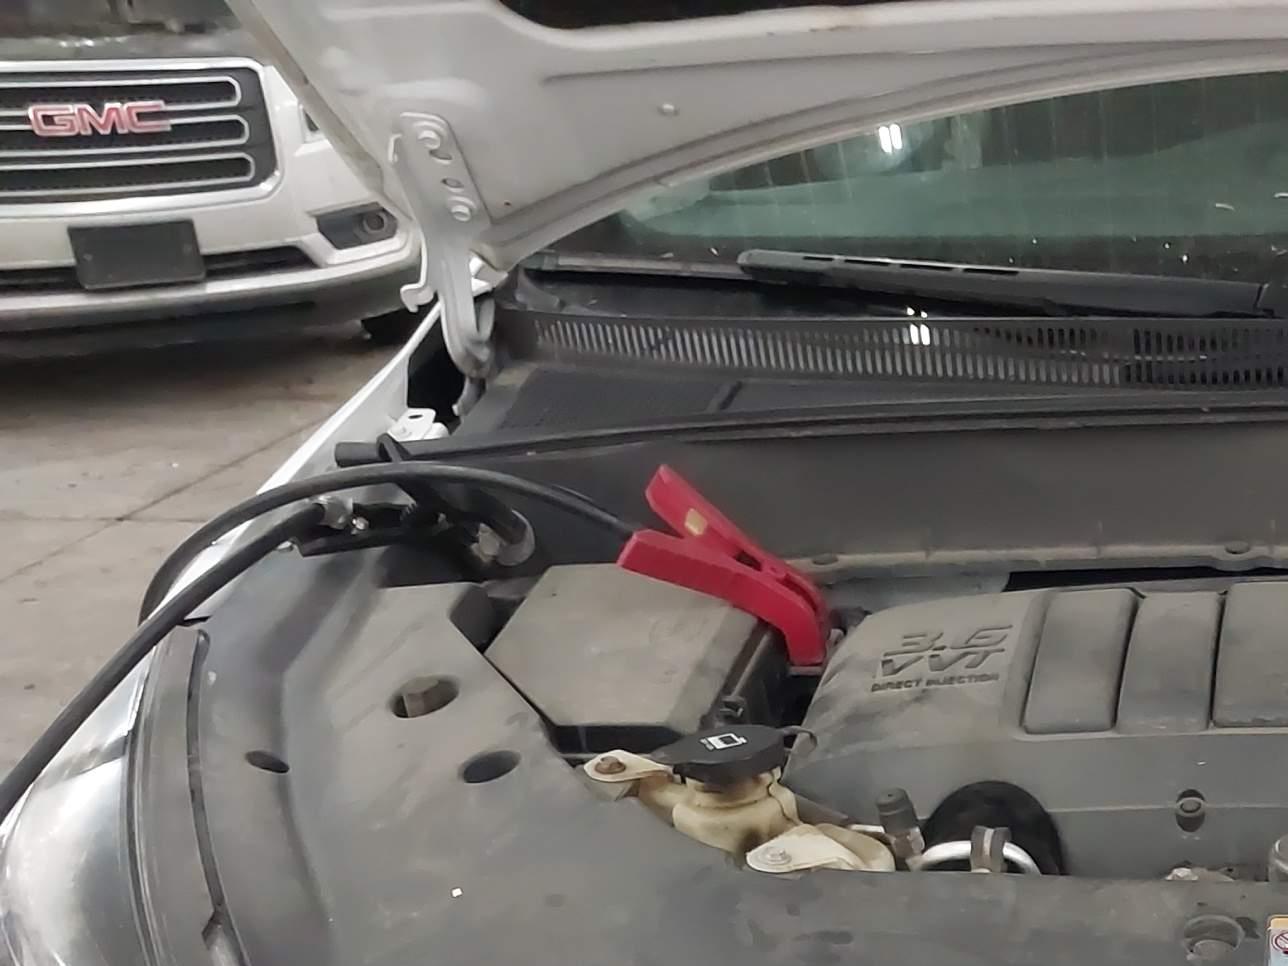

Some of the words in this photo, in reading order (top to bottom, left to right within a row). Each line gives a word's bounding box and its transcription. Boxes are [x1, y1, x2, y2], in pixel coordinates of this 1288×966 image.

[28, 100, 172, 136] GMC
[883, 625, 1013, 657] 3.6
[880, 648, 1006, 677] VVT
[871, 679, 922, 692] DIRECT
[926, 673, 999, 687] INJECTION
